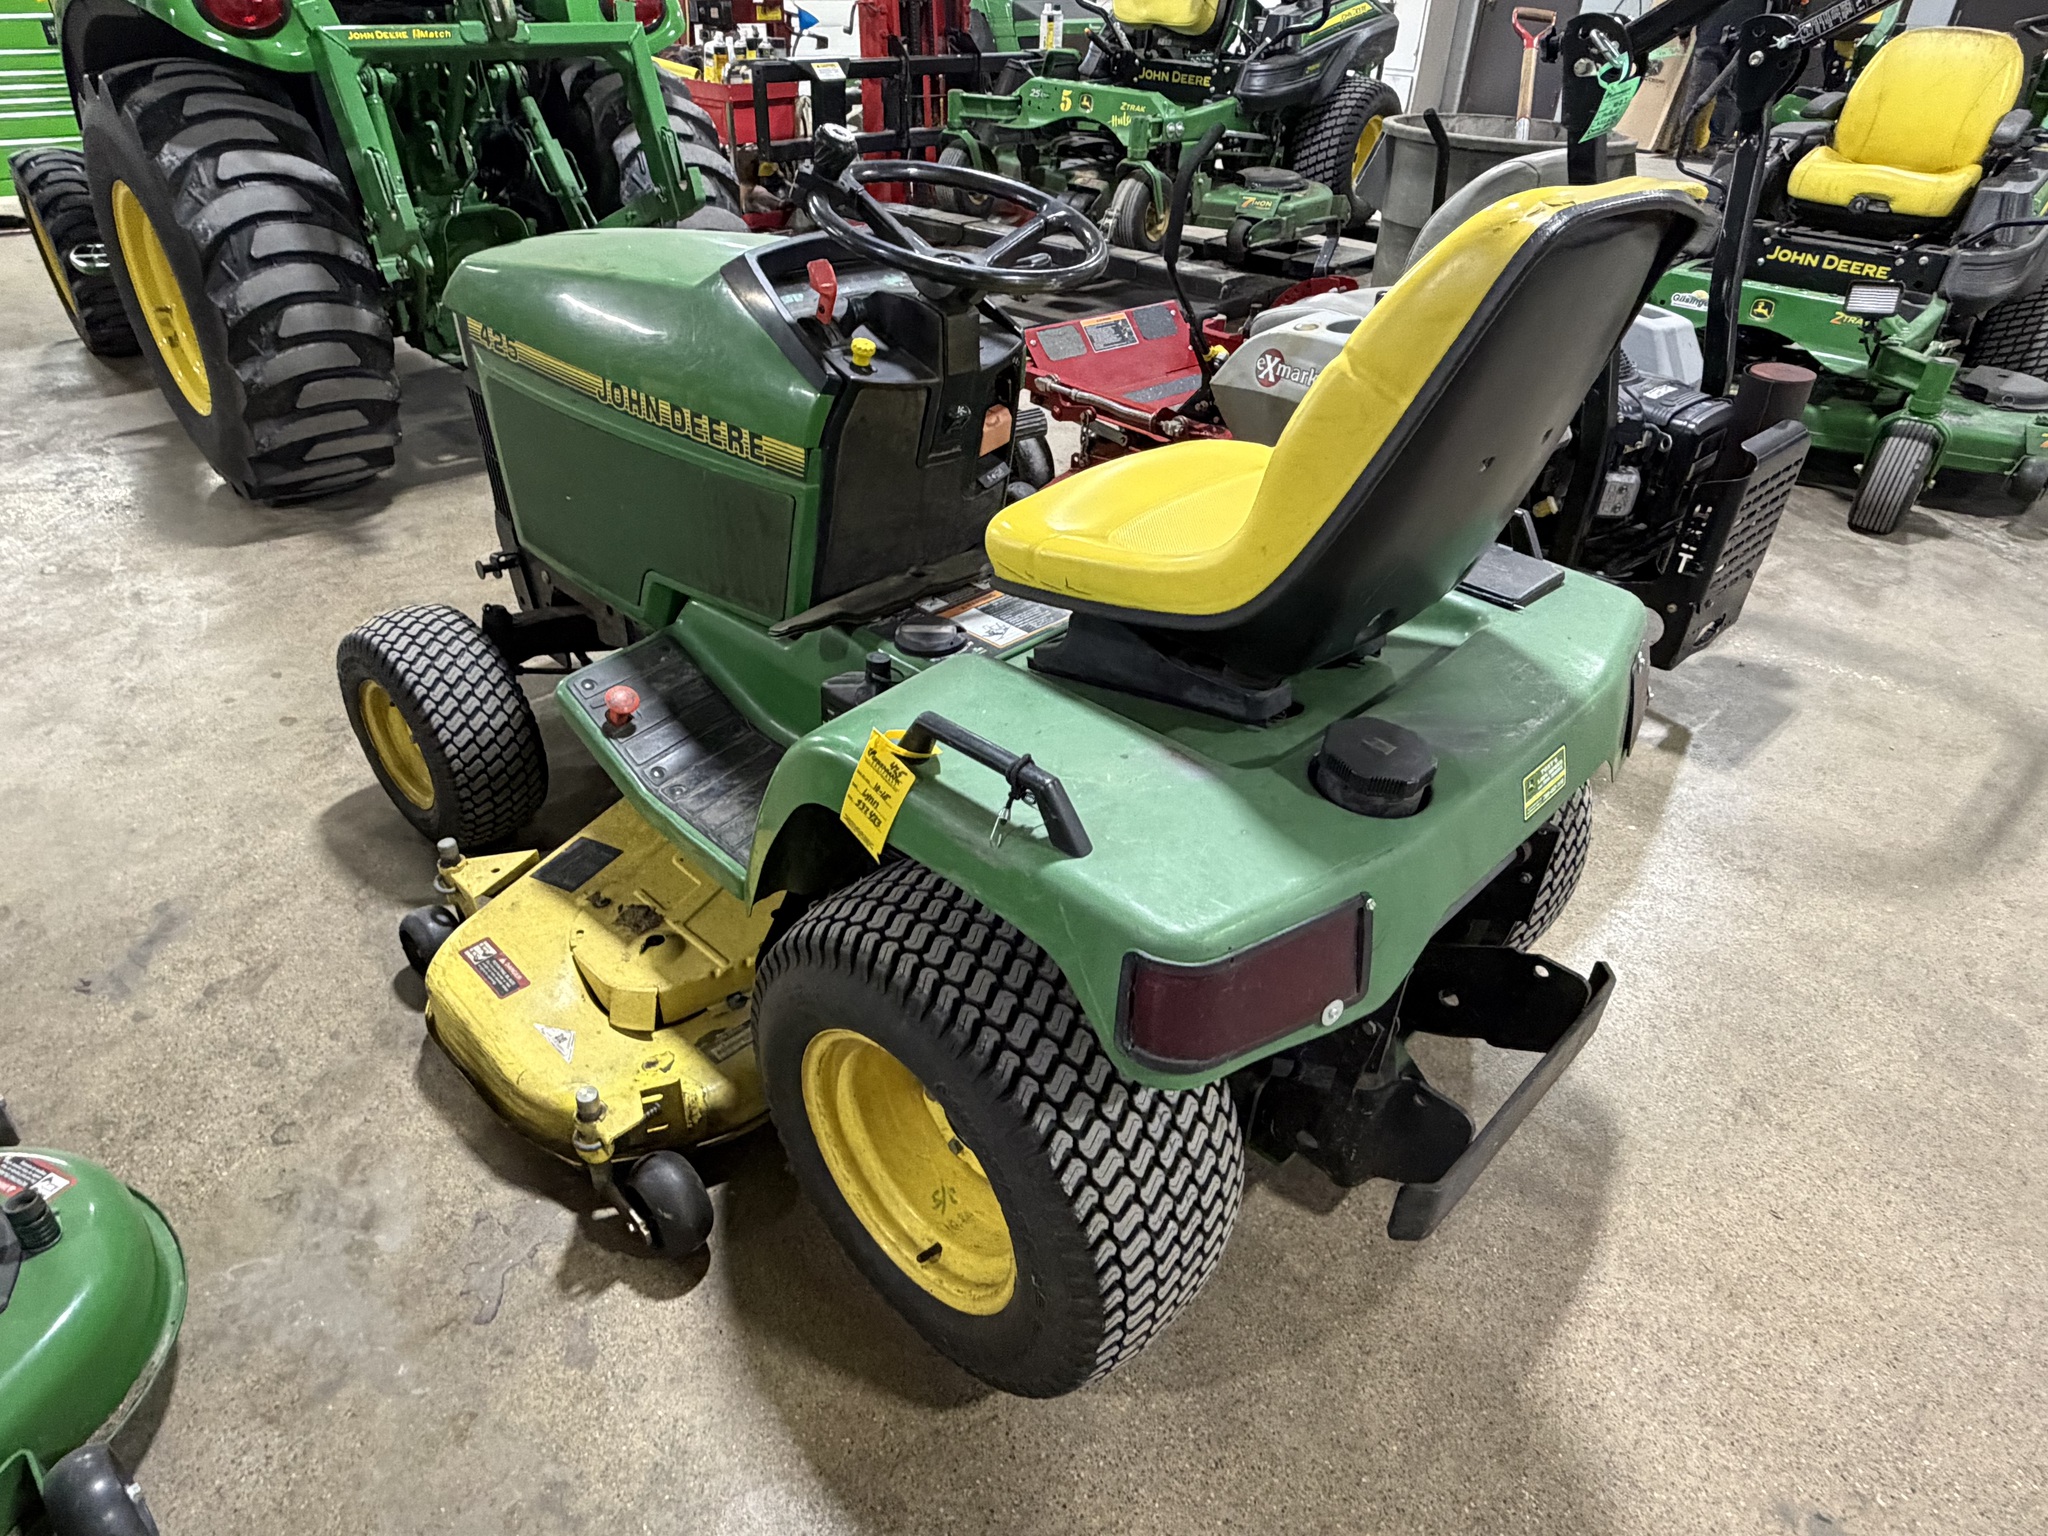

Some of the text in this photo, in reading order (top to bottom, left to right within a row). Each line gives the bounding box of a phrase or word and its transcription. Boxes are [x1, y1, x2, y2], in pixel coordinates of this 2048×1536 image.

[348, 31, 374, 41] JOHN
[375, 30, 409, 39] DEERE
[1138, 66, 1212, 87] JOHN DEERE
[1060, 89, 1073, 112] 5
[1766, 245, 1892, 280] JOHN DEERE
[481, 324, 520, 362] 425
[597, 377, 767, 465] JOHN DEERE
